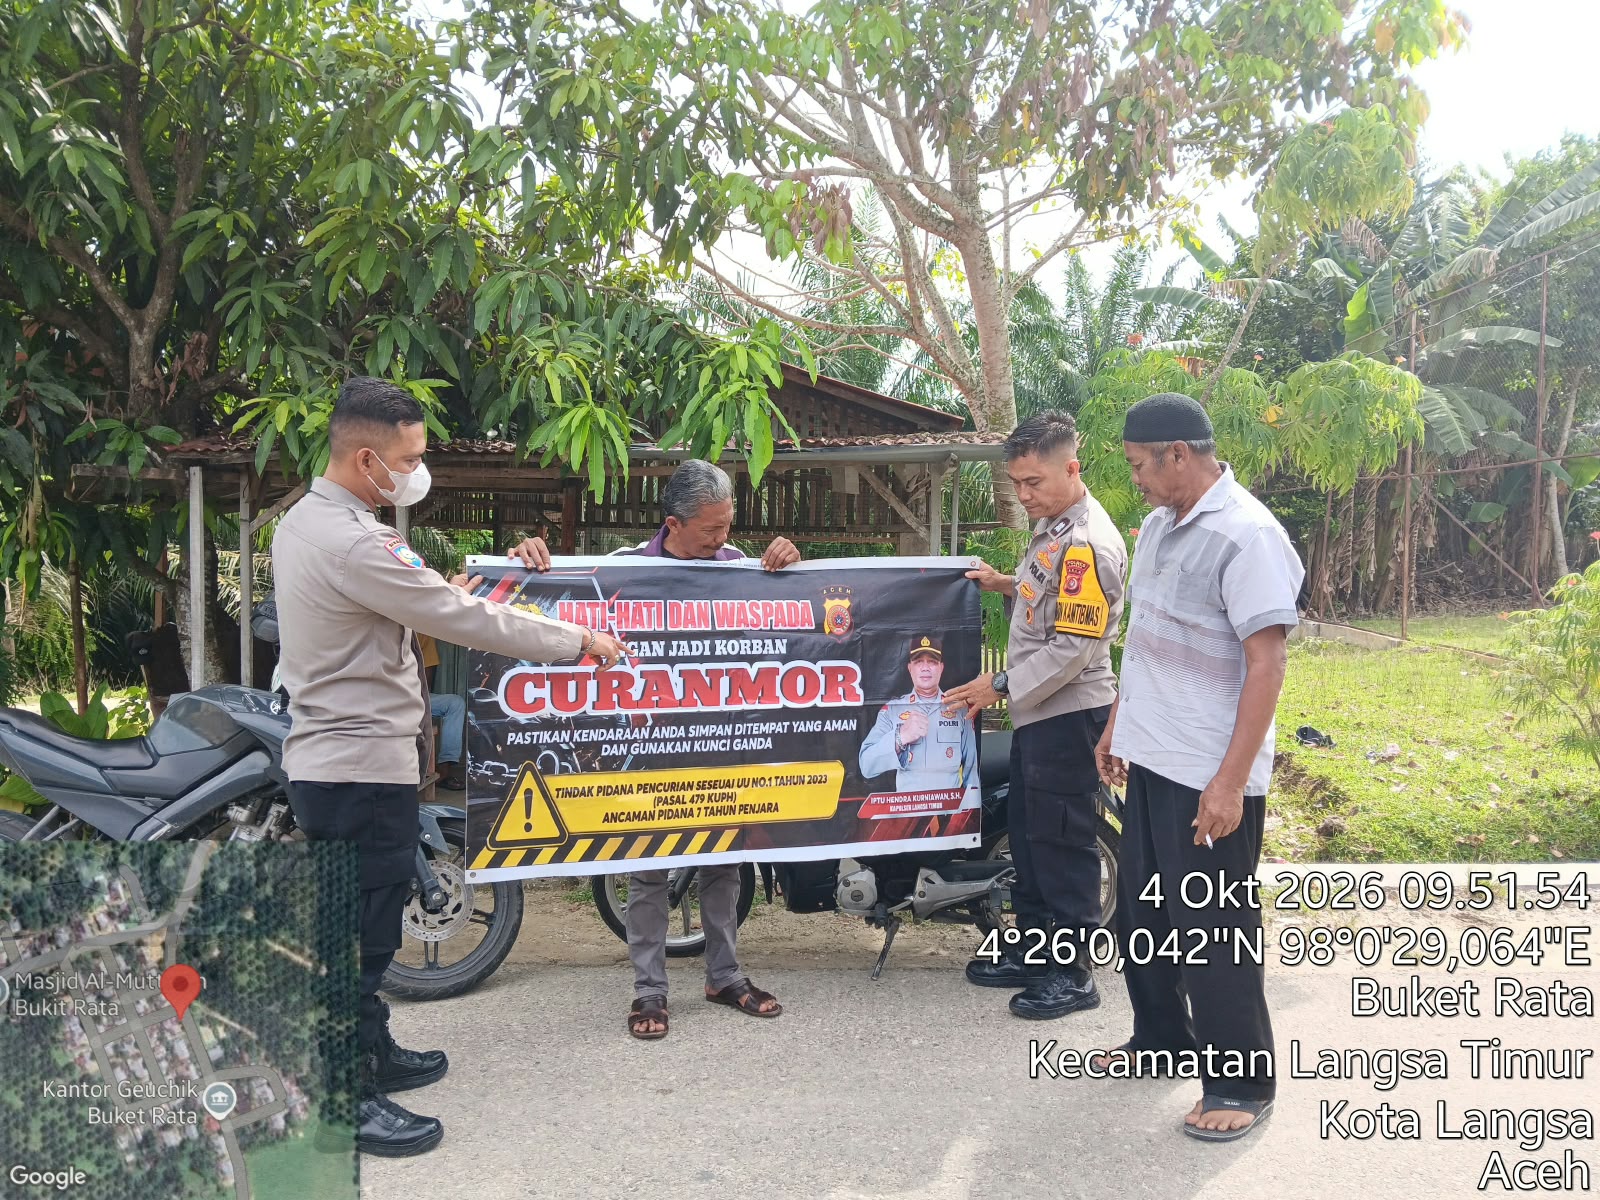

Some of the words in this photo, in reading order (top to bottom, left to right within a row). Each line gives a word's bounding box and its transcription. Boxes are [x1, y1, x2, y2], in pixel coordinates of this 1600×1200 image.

[1029, 561, 1047, 585] POLRI
[558, 600, 664, 631] HATI-HATI
[667, 600, 711, 631] DAN
[713, 600, 815, 630] WASPADA
[669, 639, 711, 657] JADI
[714, 638, 788, 656] KORBAN
[503, 663, 862, 715] CURANMOR
[506, 729, 571, 746] PASTIKAN
[572, 726, 650, 743] KENDARAAN
[651, 725, 686, 739] ANDA
[688, 723, 733, 738] SIMPAN
[734, 721, 791, 736] DITEMPAT
[792, 720, 822, 733] YANG
[823, 719, 857, 732] AMAN
[601, 743, 629, 756] DAN
[630, 741, 691, 755] GUNAKAN
[693, 738, 730, 752] KUNCI
[732, 737, 773, 751] GANDA
[554, 785, 594, 799] TINDAK
[596, 784, 634, 797] PIDANA
[636, 781, 695, 795] PENCURIAN
[695, 778, 735, 791] SESEUAI
[736, 777, 750, 789] UU
[751, 776, 773, 788] NO.1
[774, 775, 805, 787] TAHUN
[806, 774, 828, 785] 2023
[870, 797, 885, 805] IPTU
[886, 795, 912, 804] HENDRA
[950, 791, 961, 800] S.H.
[653, 795, 687, 809] (PASAL
[689, 793, 706, 804] 479
[706, 791, 737, 804] KUPH)
[602, 810, 656, 824] ANCAMAN
[657, 807, 694, 820] PIDANA
[696, 807, 702, 818] 7
[703, 805, 736, 817] TAHUN
[738, 802, 779, 815] PENJARA
